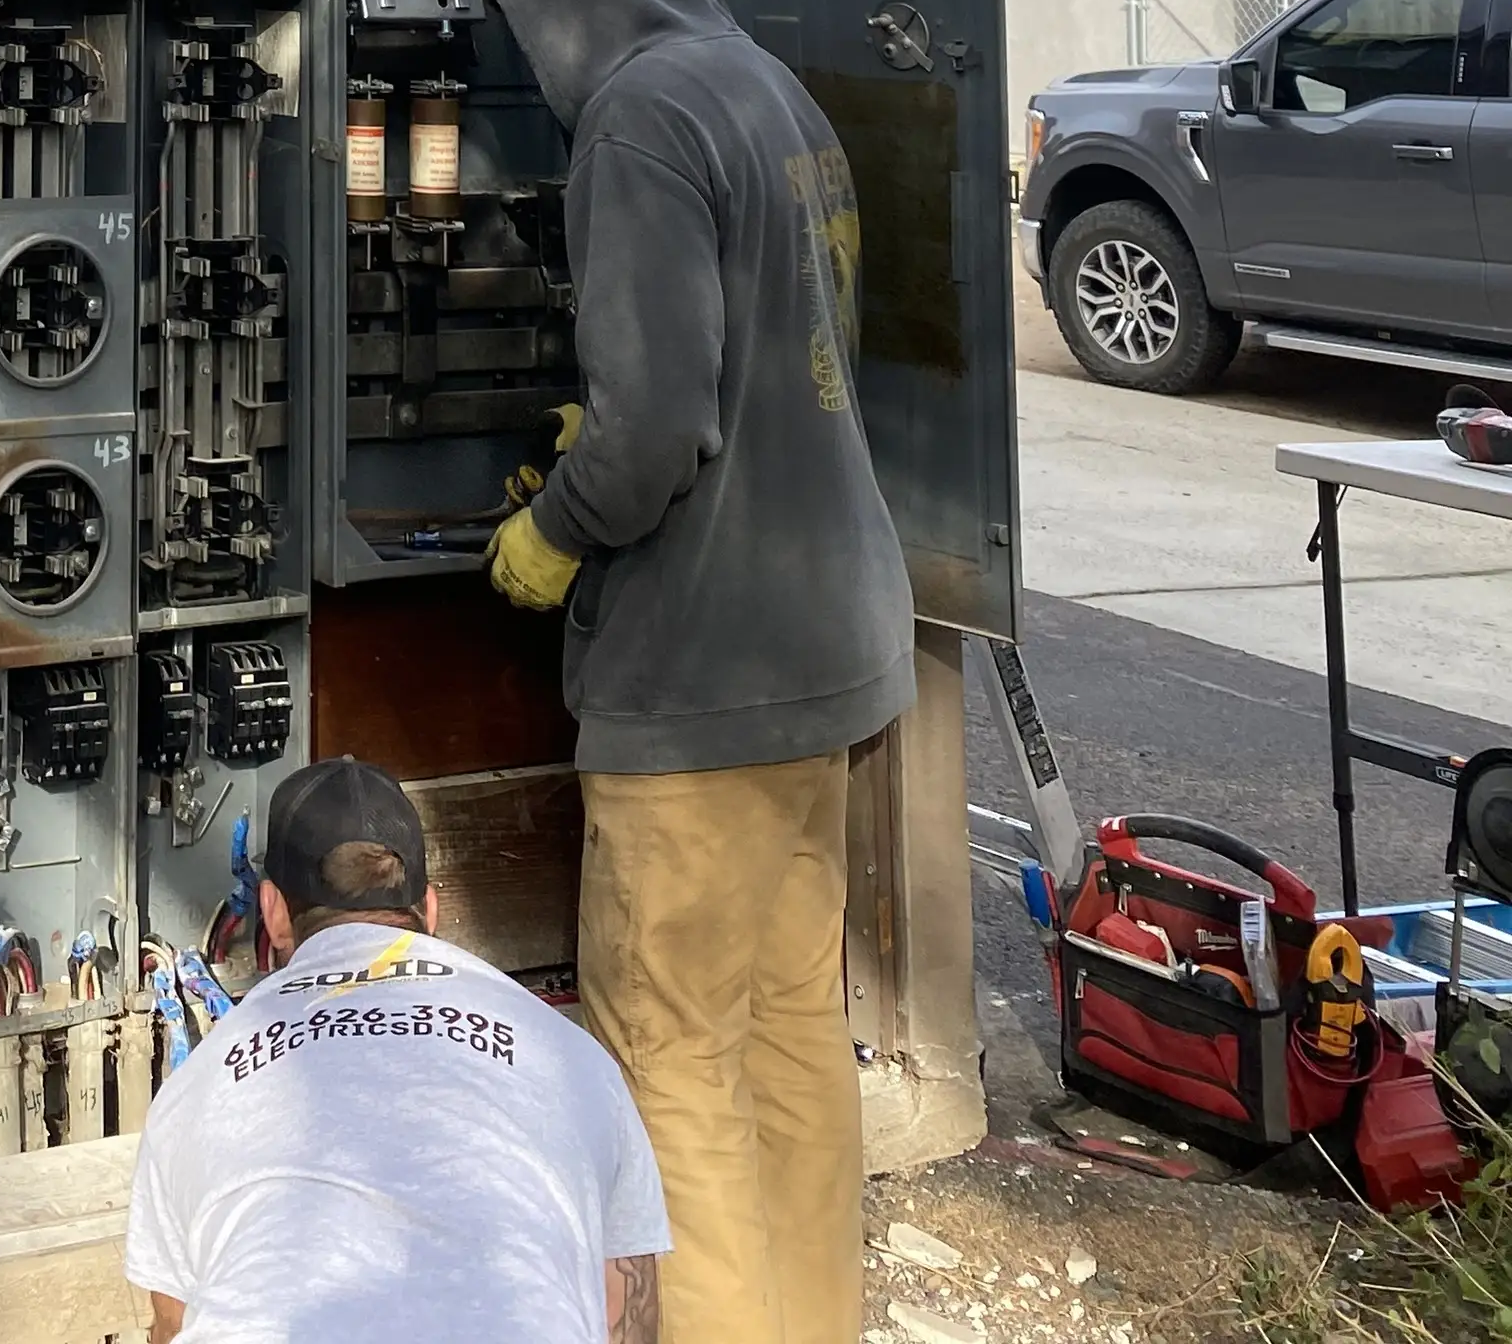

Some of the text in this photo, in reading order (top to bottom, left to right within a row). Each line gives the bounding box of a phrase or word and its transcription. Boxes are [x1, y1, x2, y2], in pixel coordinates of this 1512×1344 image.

[98, 211, 134, 245] 45
[94, 434, 131, 468] 43
[278, 959, 455, 995] SOLID
[224, 1005, 515, 1067] 619-626-3995
[234, 1021, 515, 1084] ELECTRICSD.COM
[80, 1088, 97, 1112] 43
